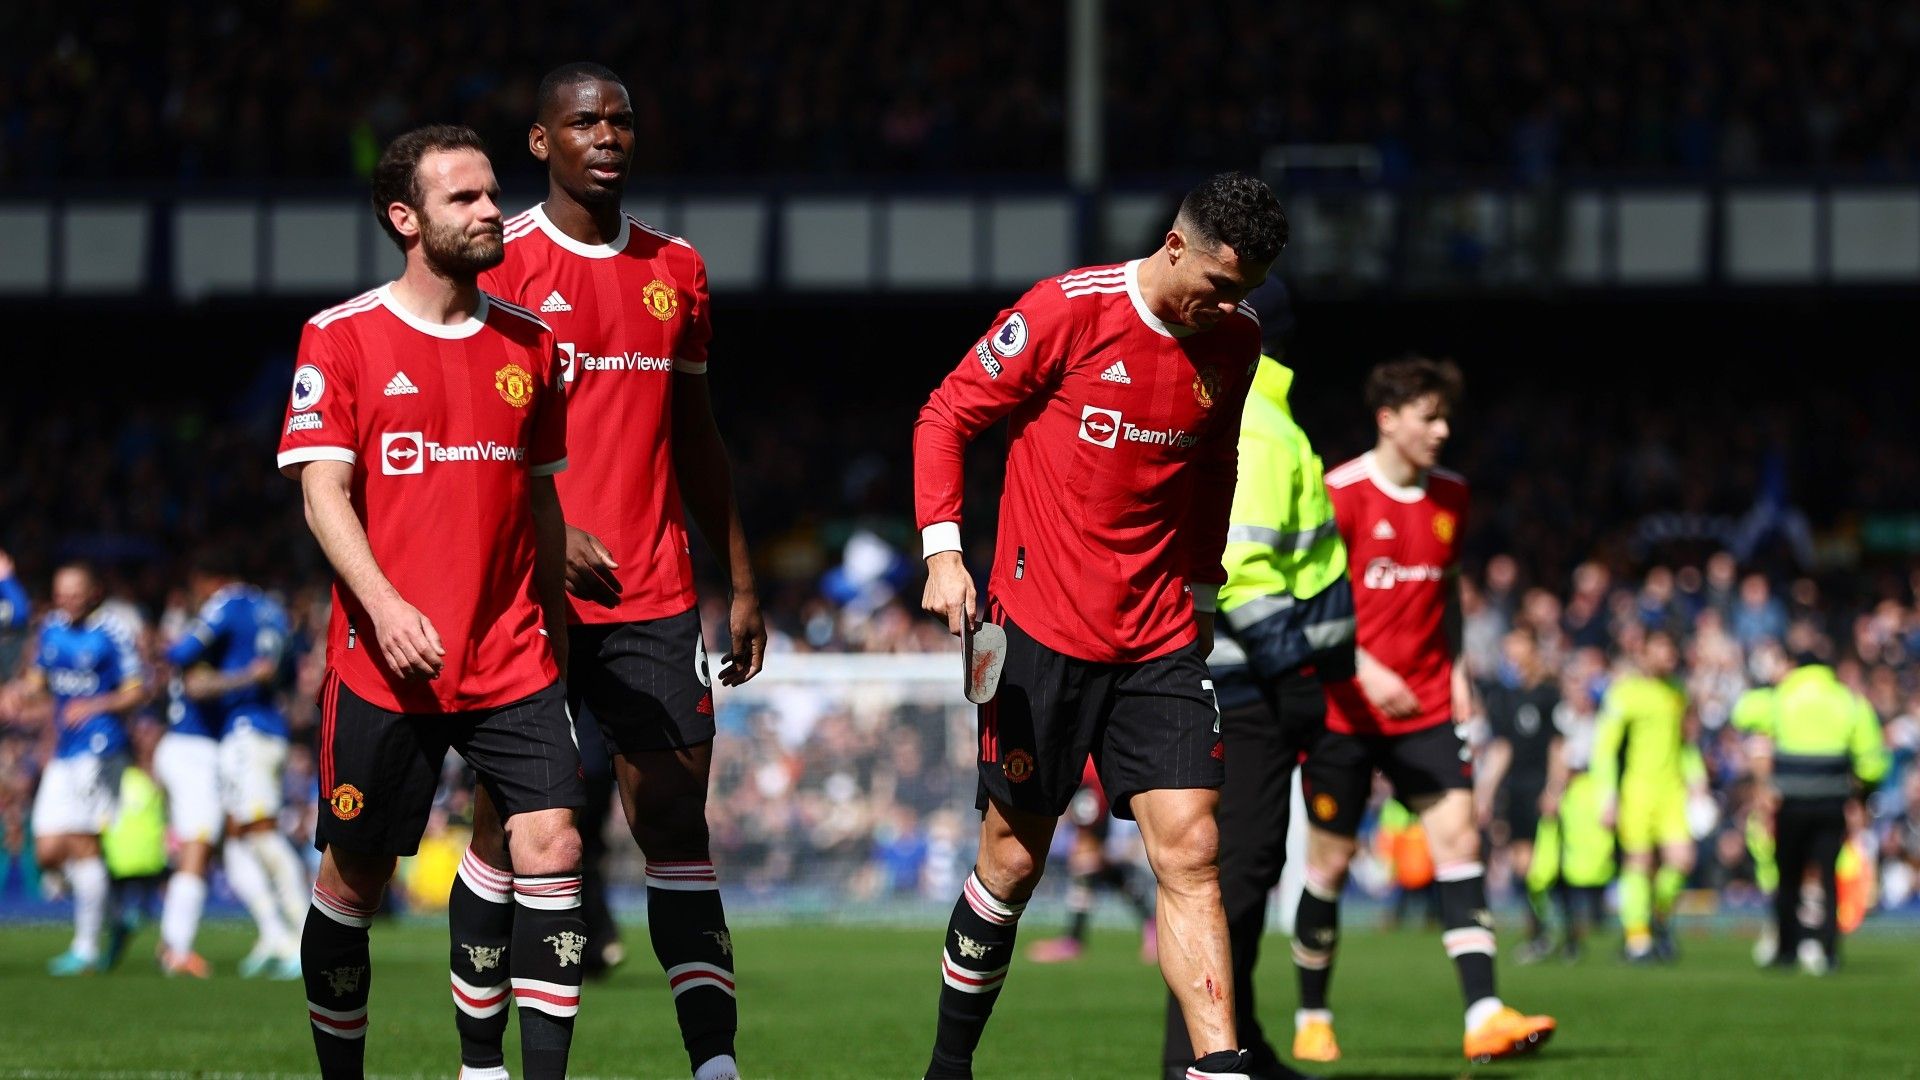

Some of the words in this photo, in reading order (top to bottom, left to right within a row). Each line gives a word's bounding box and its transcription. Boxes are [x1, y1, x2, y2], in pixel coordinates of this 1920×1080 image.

[540, 304, 572, 313] adidas
[1100, 372, 1131, 385] adidas
[383, 386, 419, 396] adidas
[293, 412, 318, 424] room
[1123, 422, 1198, 448] TeamView
